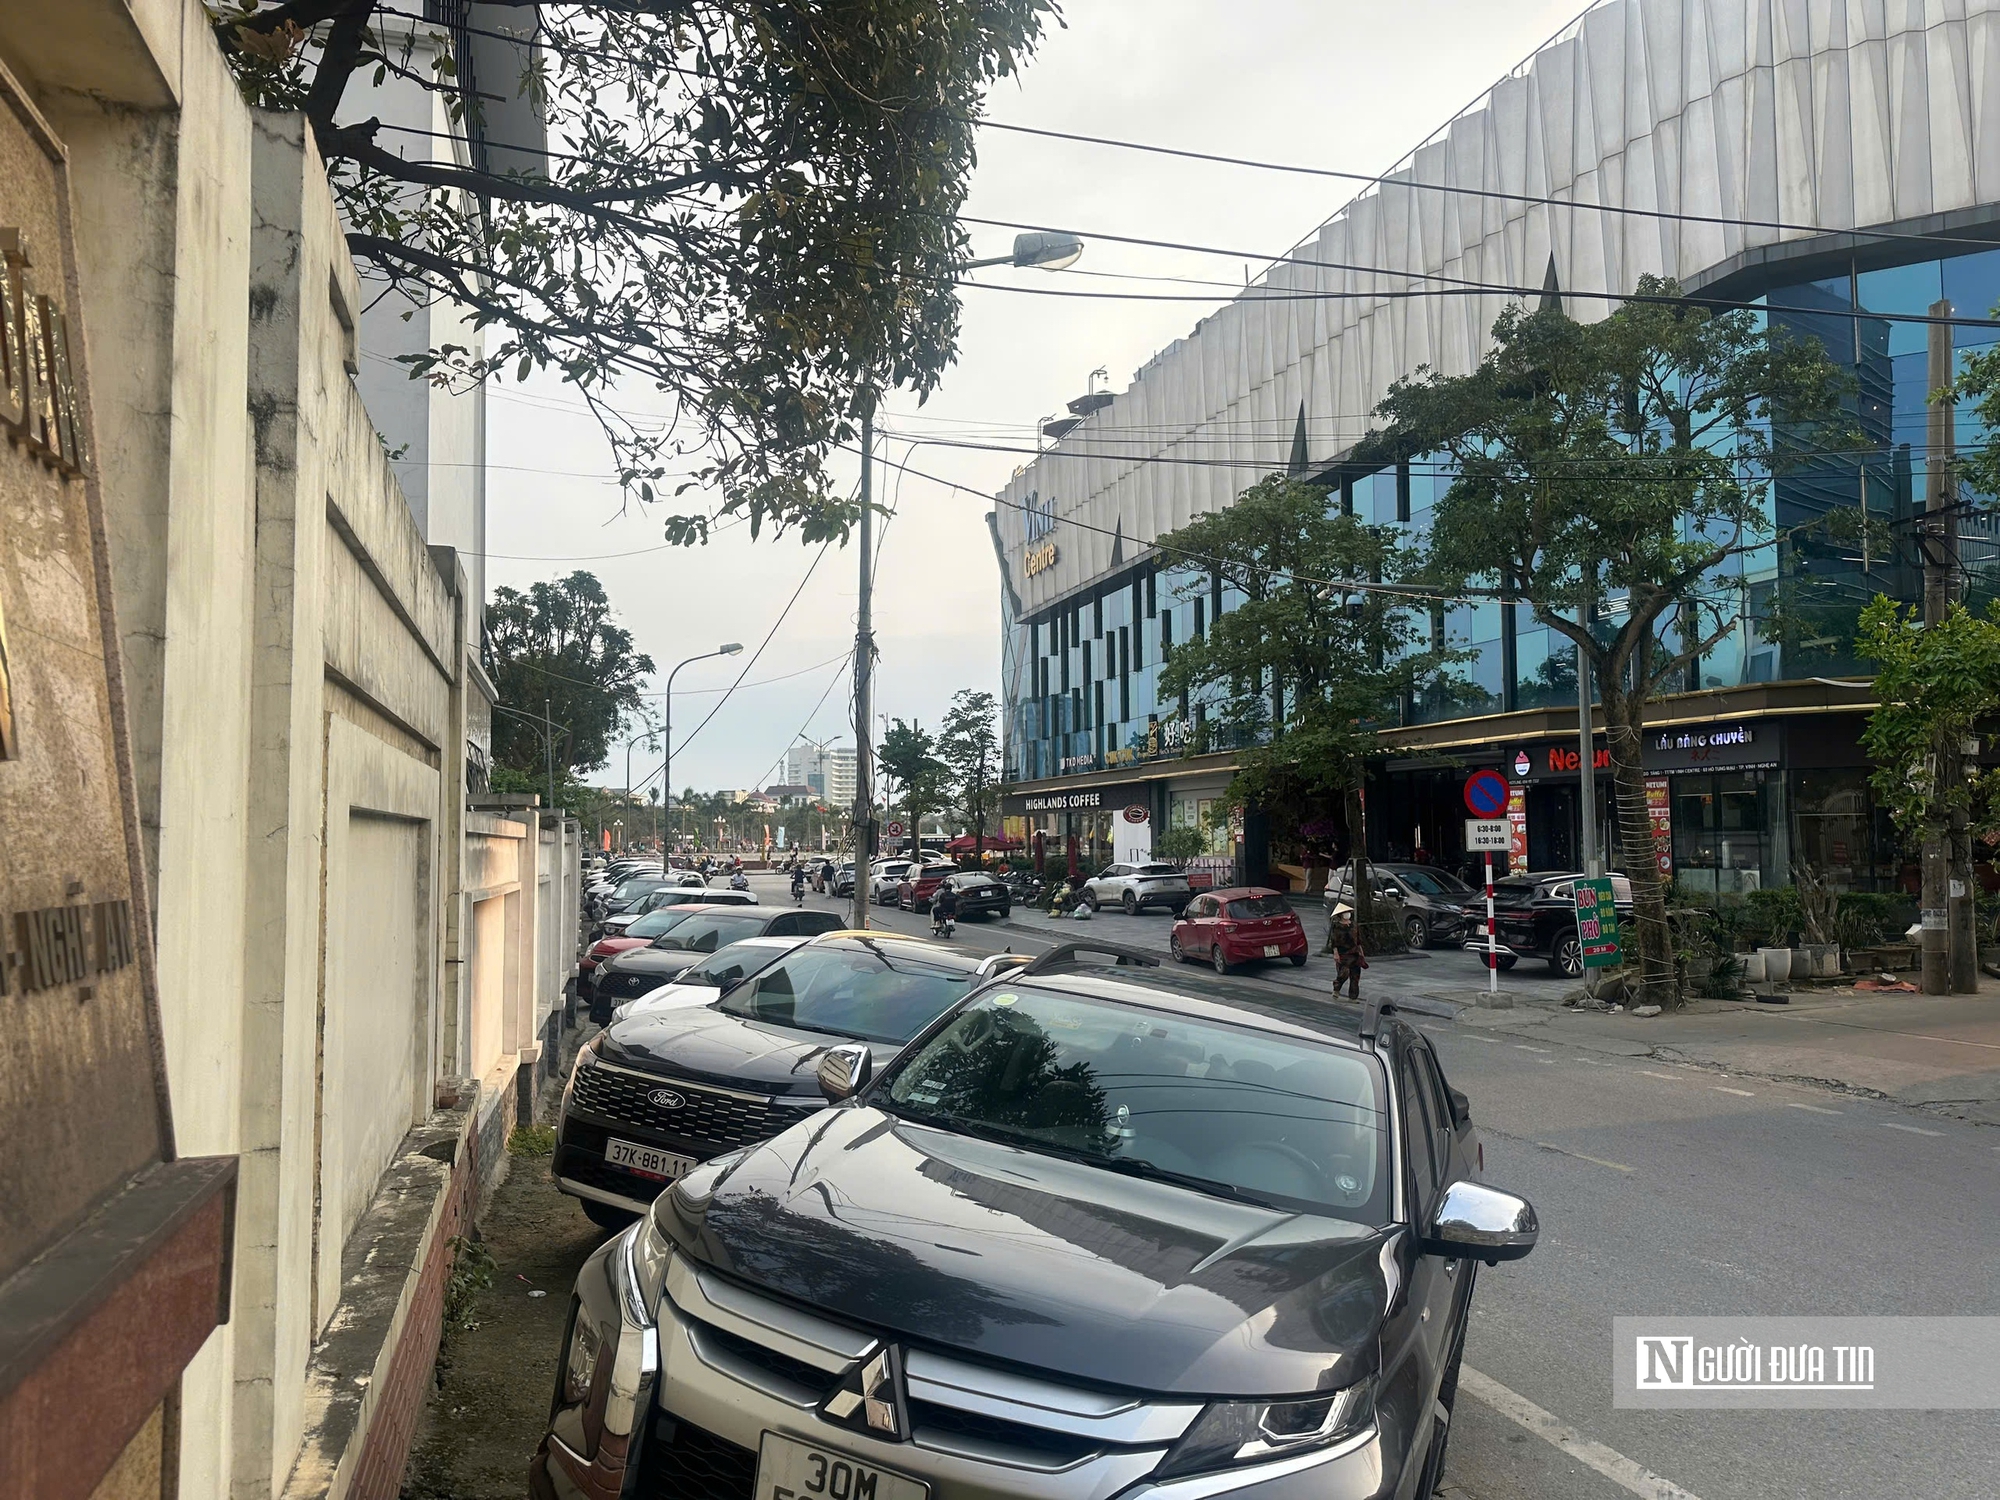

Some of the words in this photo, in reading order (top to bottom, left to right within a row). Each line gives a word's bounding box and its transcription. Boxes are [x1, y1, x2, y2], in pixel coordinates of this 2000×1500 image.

[1024, 542, 1055, 578] Centre
[1676, 733, 1707, 749] BĂNG
[1710, 726, 1753, 746] CHUYỀN
[1026, 796, 1067, 811] HIGHLANDS
[1069, 793, 1100, 808] COFFEE
[1577, 883, 1597, 909] BÚN
[1581, 912, 1600, 940] PHỞ
[654, 1091, 678, 1107] Ford
[612, 1145, 687, 1175] 37K-881.11
[805, 1453, 878, 1500] 30M
